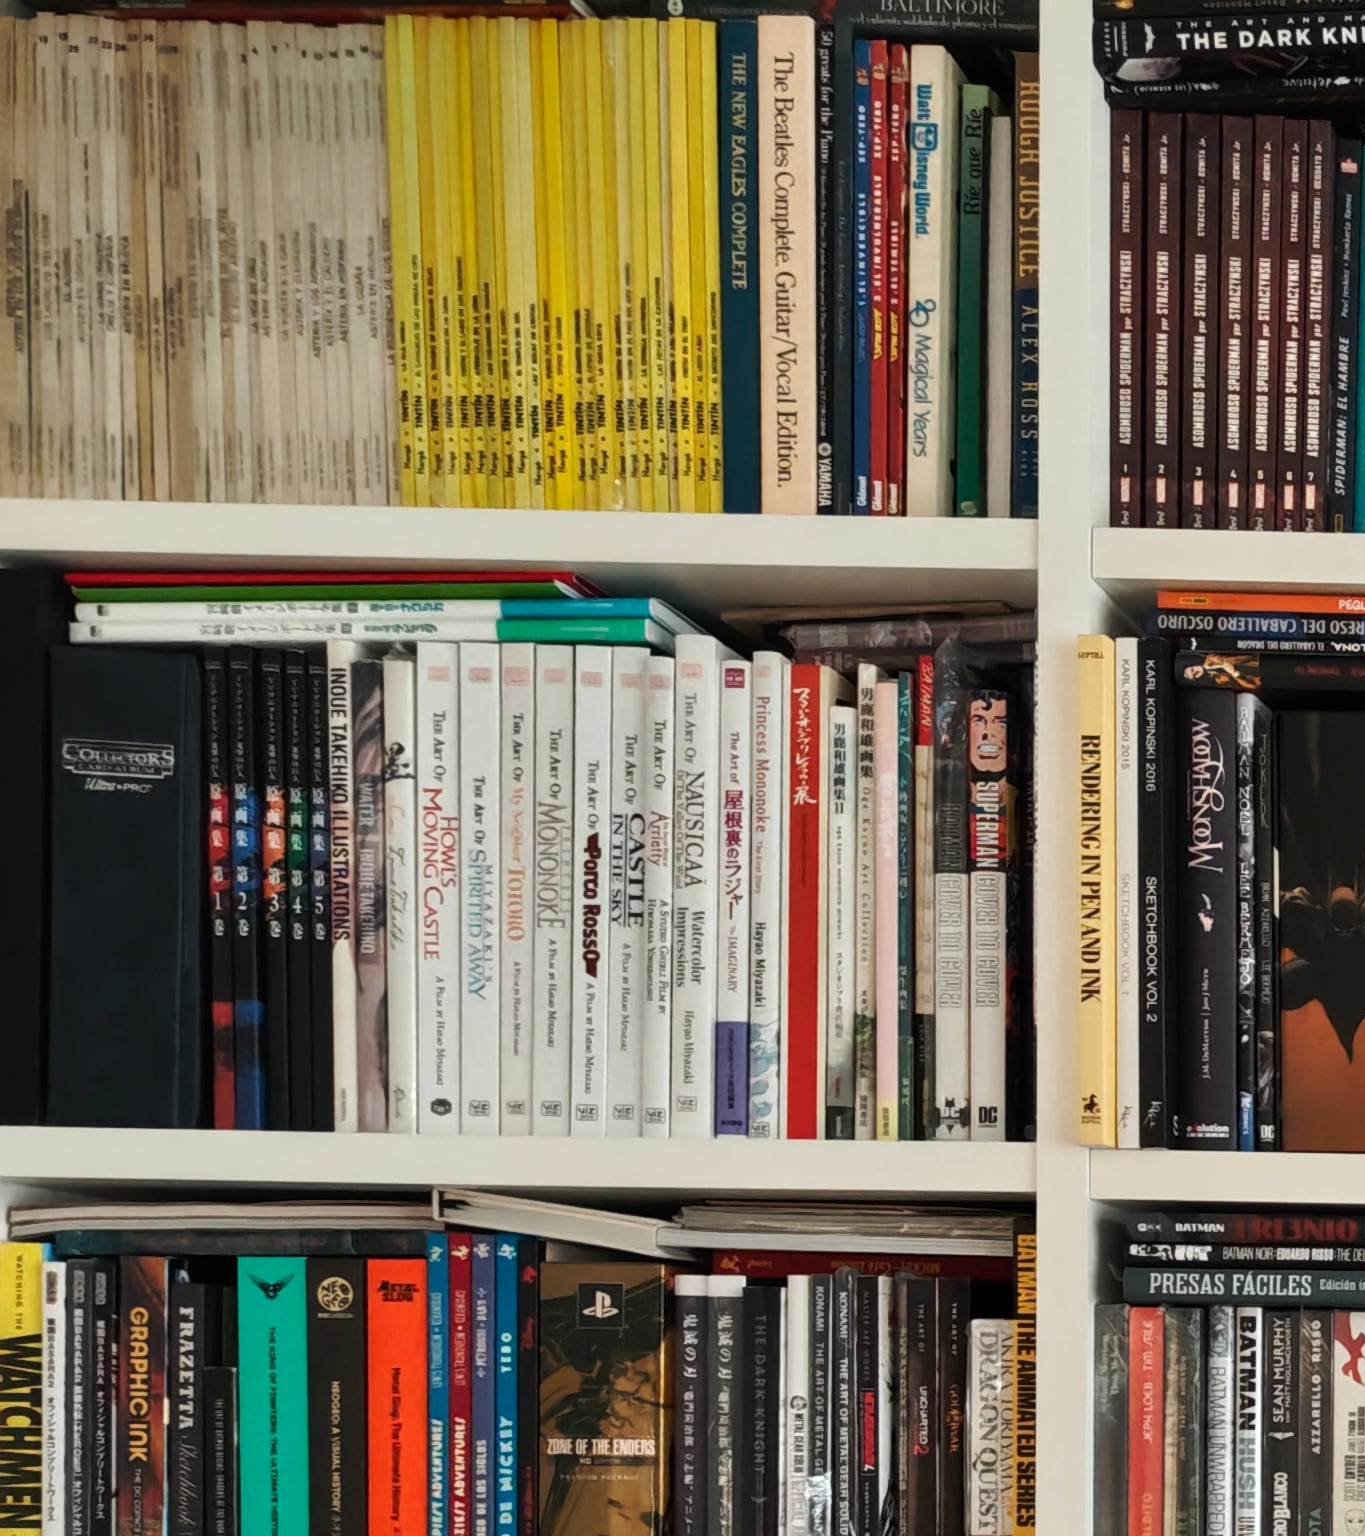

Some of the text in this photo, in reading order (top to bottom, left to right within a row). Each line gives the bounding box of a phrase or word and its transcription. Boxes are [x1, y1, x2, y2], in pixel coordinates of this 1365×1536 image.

[1177, 32, 1229, 51] THE
[1238, 28, 1313, 49] DARK
[731, 52, 747, 290] THE NEW EAGLES COMPLETE
[770, 52, 798, 489] The Beatles Complete. Guitar/Vocal Edition.
[818, 457, 831, 506] YAMAHA
[330, 667, 351, 942] INOUE TAKEHIKO ILLUSTRATIONS
[975, 781, 998, 870] SUPERMAN
[1080, 734, 1102, 1004] RENDERING IN PEN AND INK
[1149, 1272, 1225, 1295] PRESAS
[1232, 1269, 1311, 1297] FÁCILES
[1319, 1279, 1355, 1291] Edición
[128, 1307, 150, 1462] GRAPHIC INK
[179, 1306, 195, 1429] FRAZETTA
[546, 1439, 655, 1456] ZONE OF THE ENDERS
